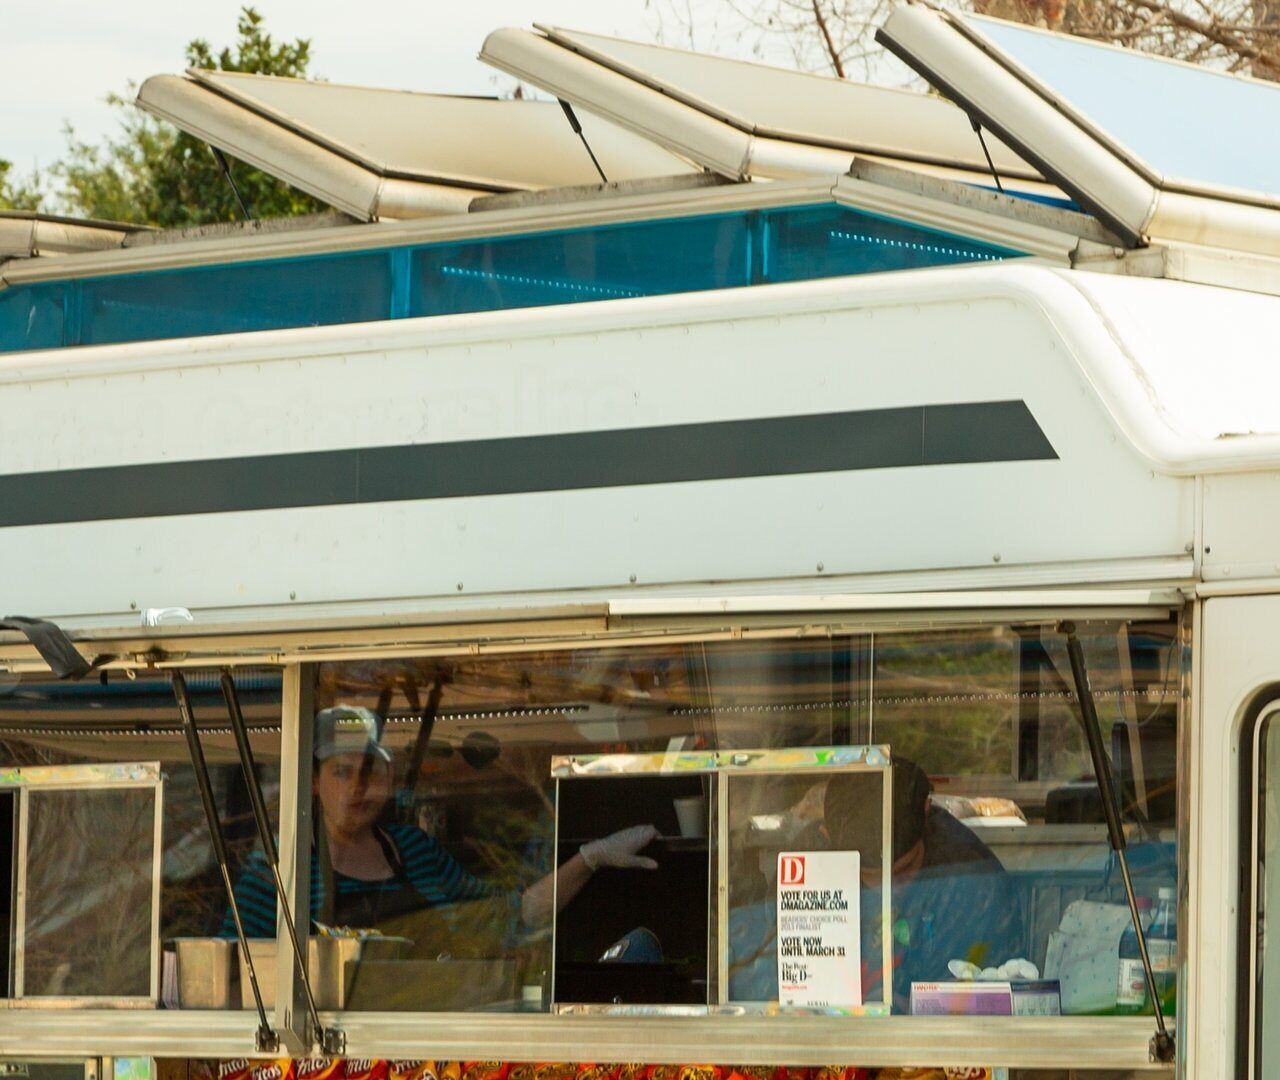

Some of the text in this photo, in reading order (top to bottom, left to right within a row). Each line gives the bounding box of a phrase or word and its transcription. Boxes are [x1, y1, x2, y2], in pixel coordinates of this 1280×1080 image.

[783, 857, 804, 884] D
[780, 890, 842, 901] VOTE FOR US AT
[780, 900, 848, 911] DMAGAZINE.COM
[781, 936, 822, 946] VOTE NOW
[780, 946, 845, 956] UNTIL MARCH 31
[782, 969, 798, 984] Big
